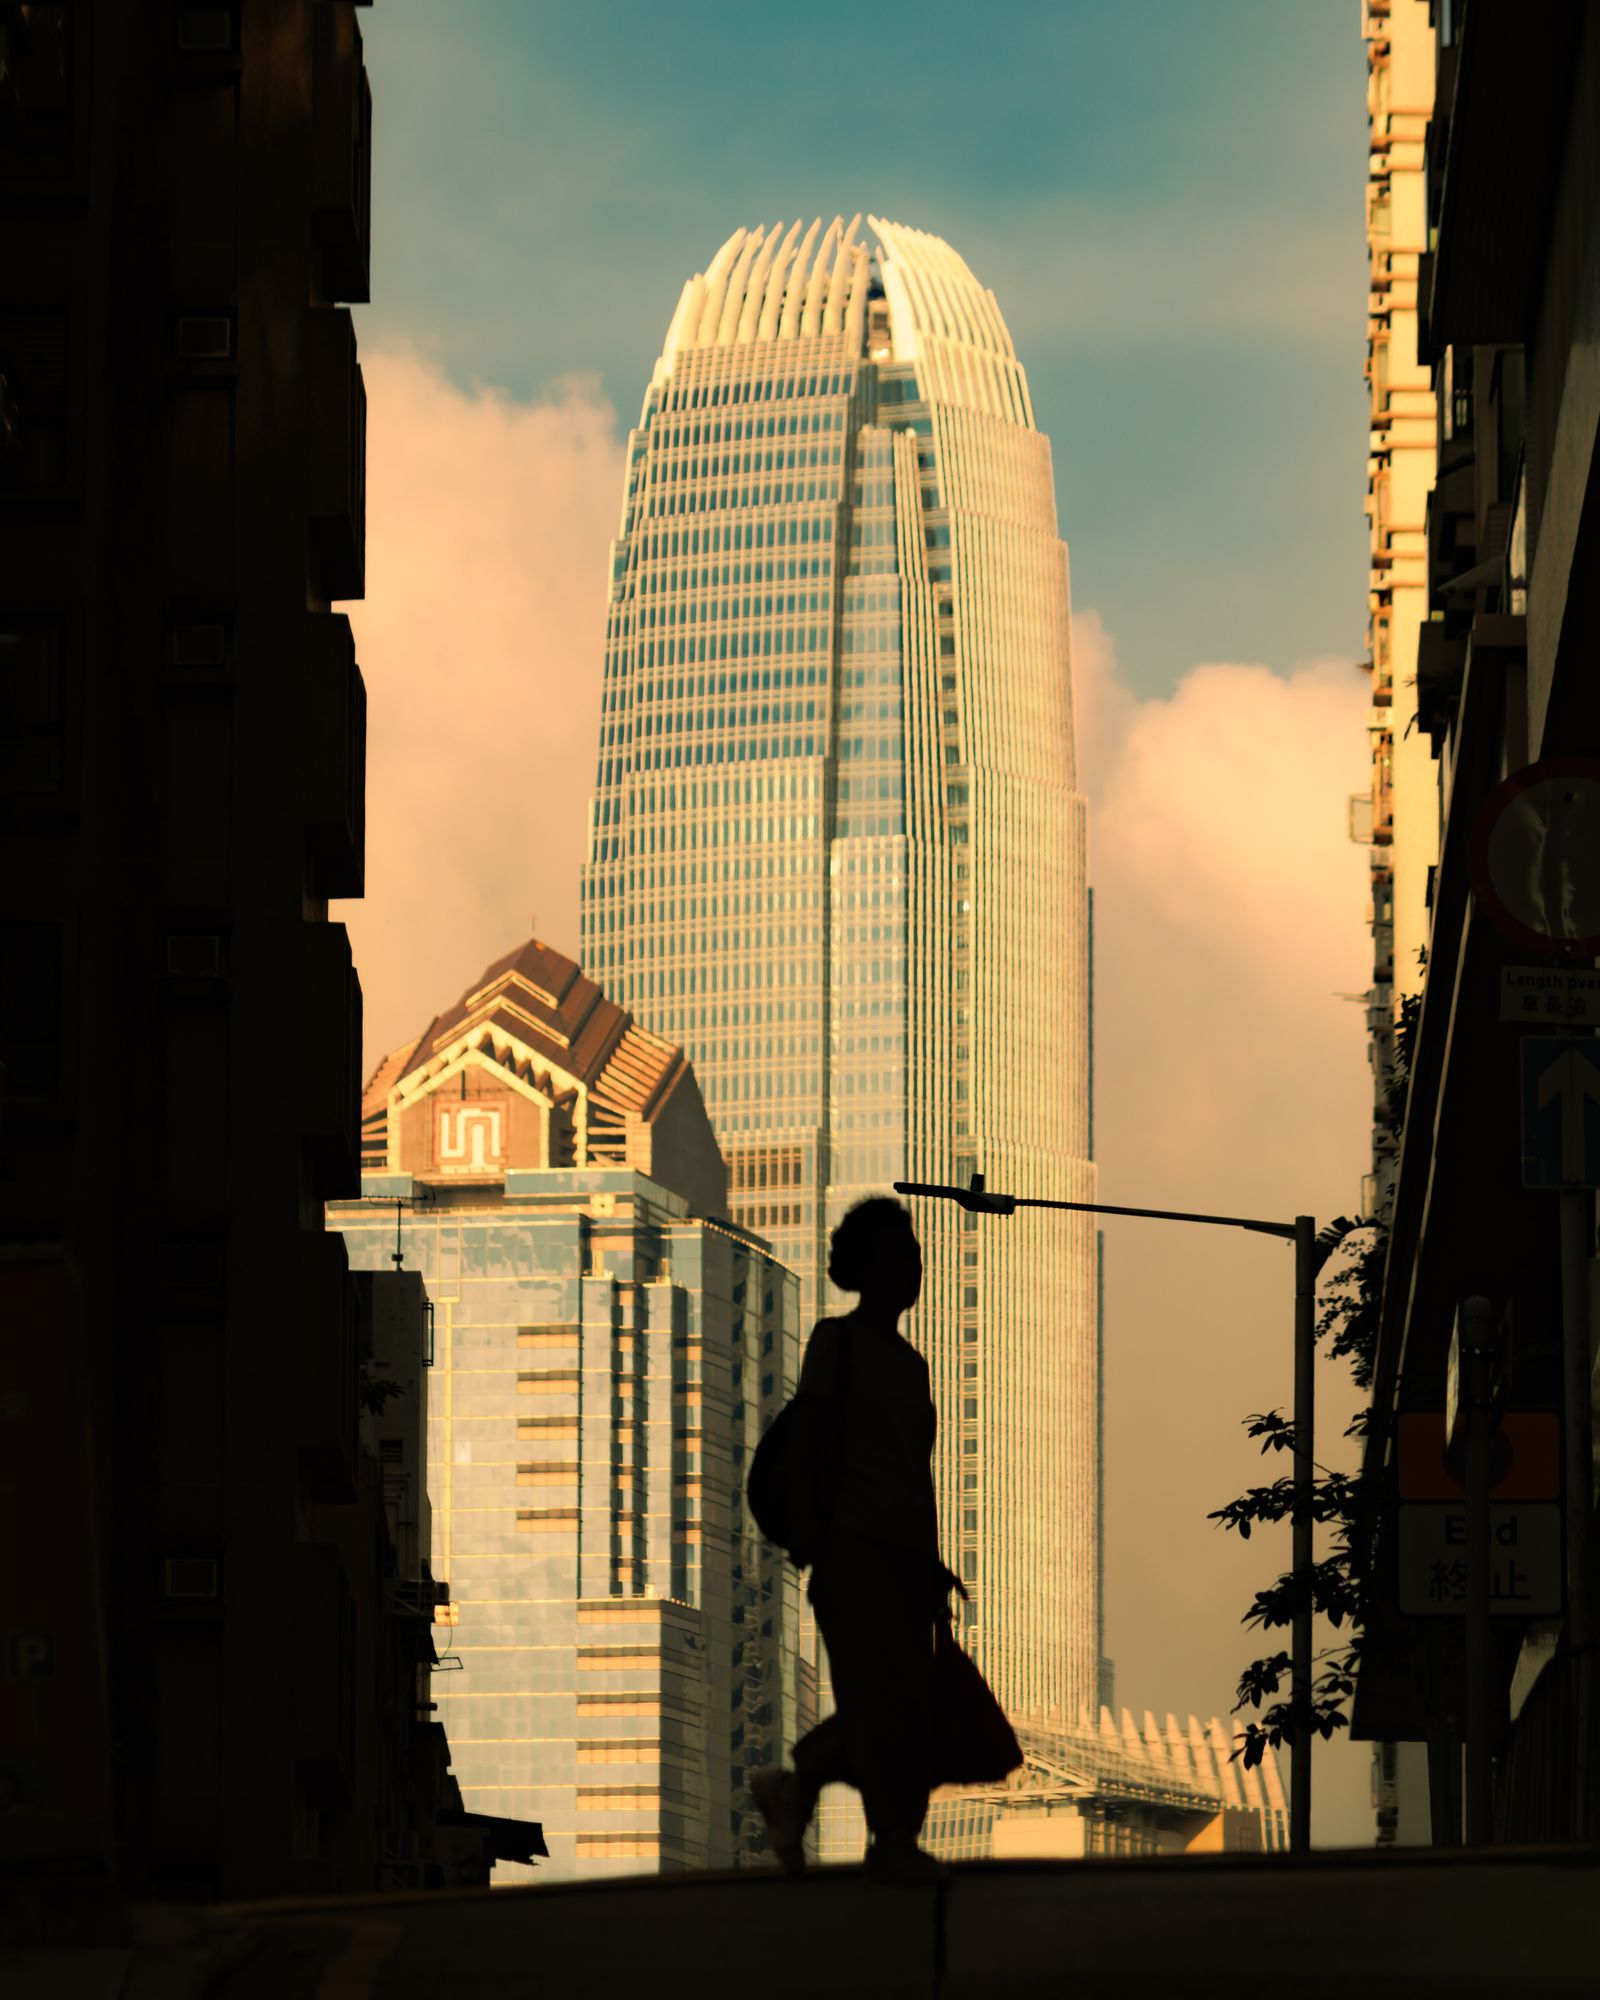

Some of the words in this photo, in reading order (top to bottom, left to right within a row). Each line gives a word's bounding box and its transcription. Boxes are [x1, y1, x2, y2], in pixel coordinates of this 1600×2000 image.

[1506, 971, 1562, 989] Length
[1445, 1515, 1517, 1545] Ed
[15, 1636, 48, 1677] P
